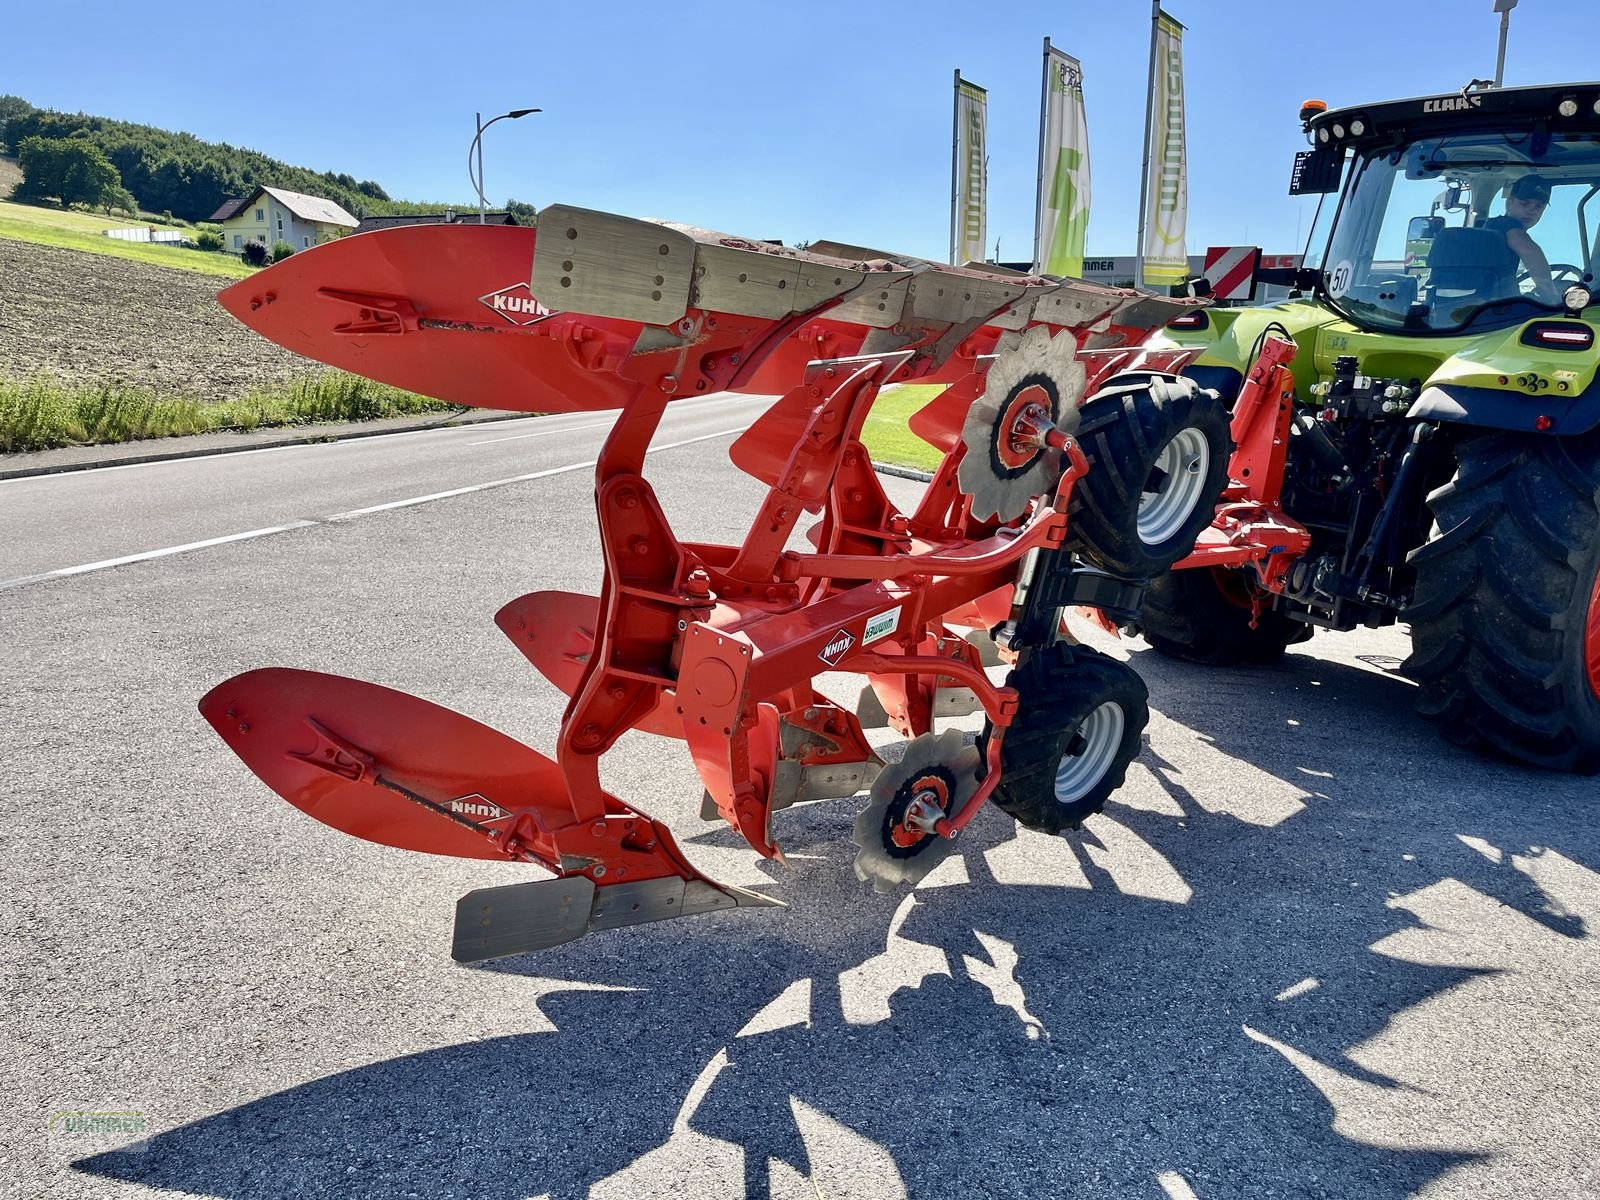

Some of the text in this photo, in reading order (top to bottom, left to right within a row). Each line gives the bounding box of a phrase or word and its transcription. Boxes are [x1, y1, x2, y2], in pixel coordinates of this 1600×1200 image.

[1083, 261, 1114, 271] MMER
[1332, 267, 1349, 292] 50
[493, 294, 550, 316] KUHN
[823, 636, 851, 659] KUHN
[451, 801, 500, 818] KUHN
